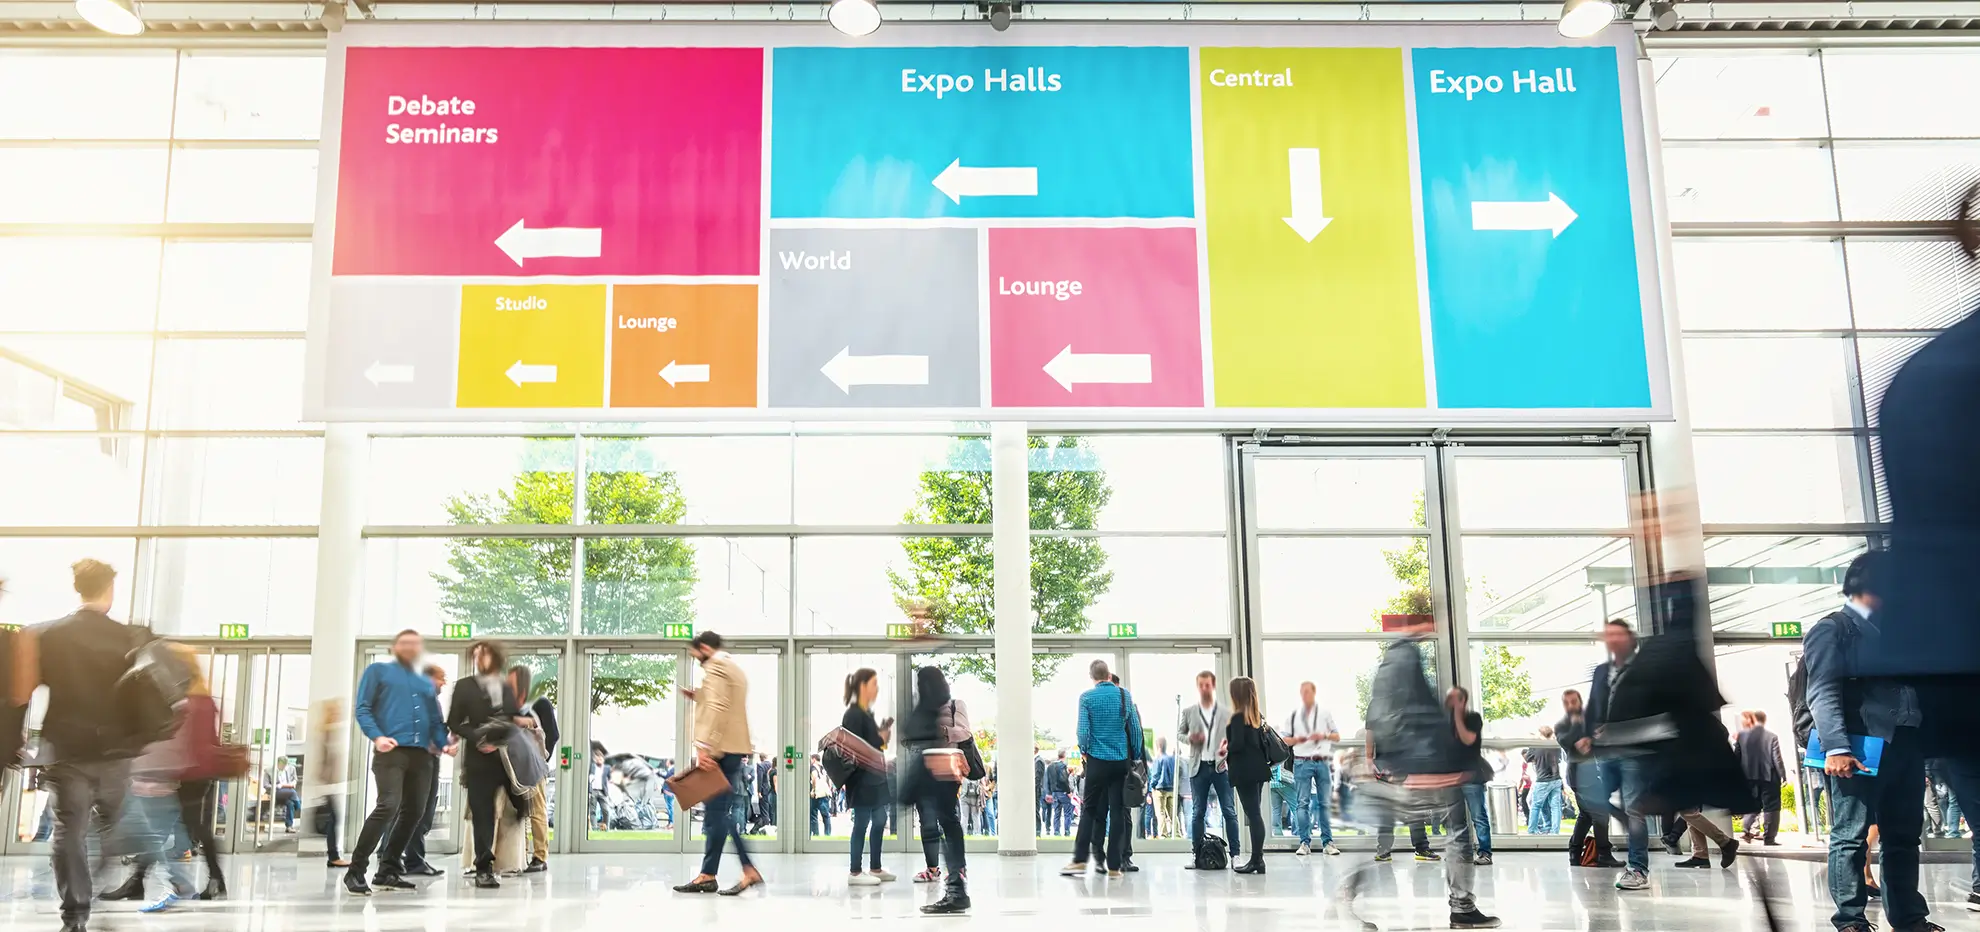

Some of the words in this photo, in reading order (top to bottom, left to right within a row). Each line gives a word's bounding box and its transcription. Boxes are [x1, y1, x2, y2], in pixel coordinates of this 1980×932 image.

[902, 69, 974, 99] Expo
[984, 67, 1062, 92] Halls
[1209, 68, 1293, 88] Central
[1431, 69, 1504, 100] Expo
[1513, 67, 1577, 93] Hall
[387, 95, 476, 116] Debate
[385, 122, 498, 143] Seminars
[778, 250, 851, 270] World
[999, 277, 1083, 301] Lounge
[495, 295, 547, 311] Studio
[618, 314, 677, 332] Lounge
